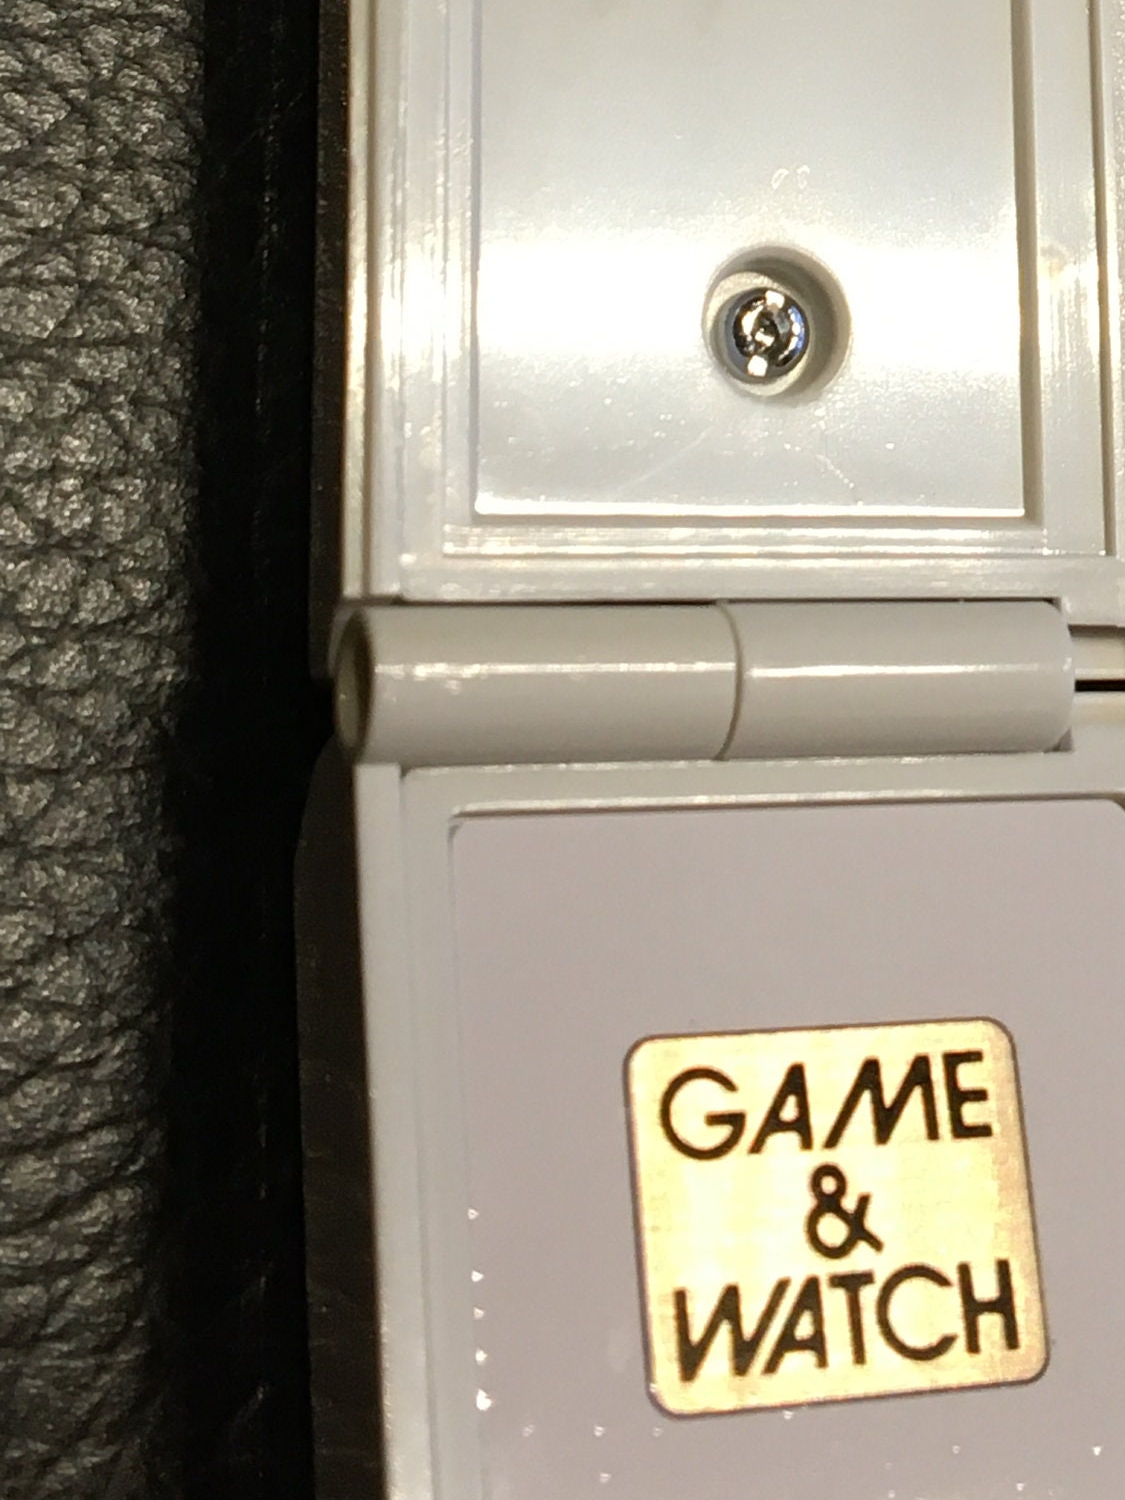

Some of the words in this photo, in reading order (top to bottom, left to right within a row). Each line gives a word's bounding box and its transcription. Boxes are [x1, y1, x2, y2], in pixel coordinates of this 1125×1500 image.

[660, 1050, 993, 1161] GAME
[805, 1163, 884, 1260] &
[673, 1258, 1020, 1383] WATCH
